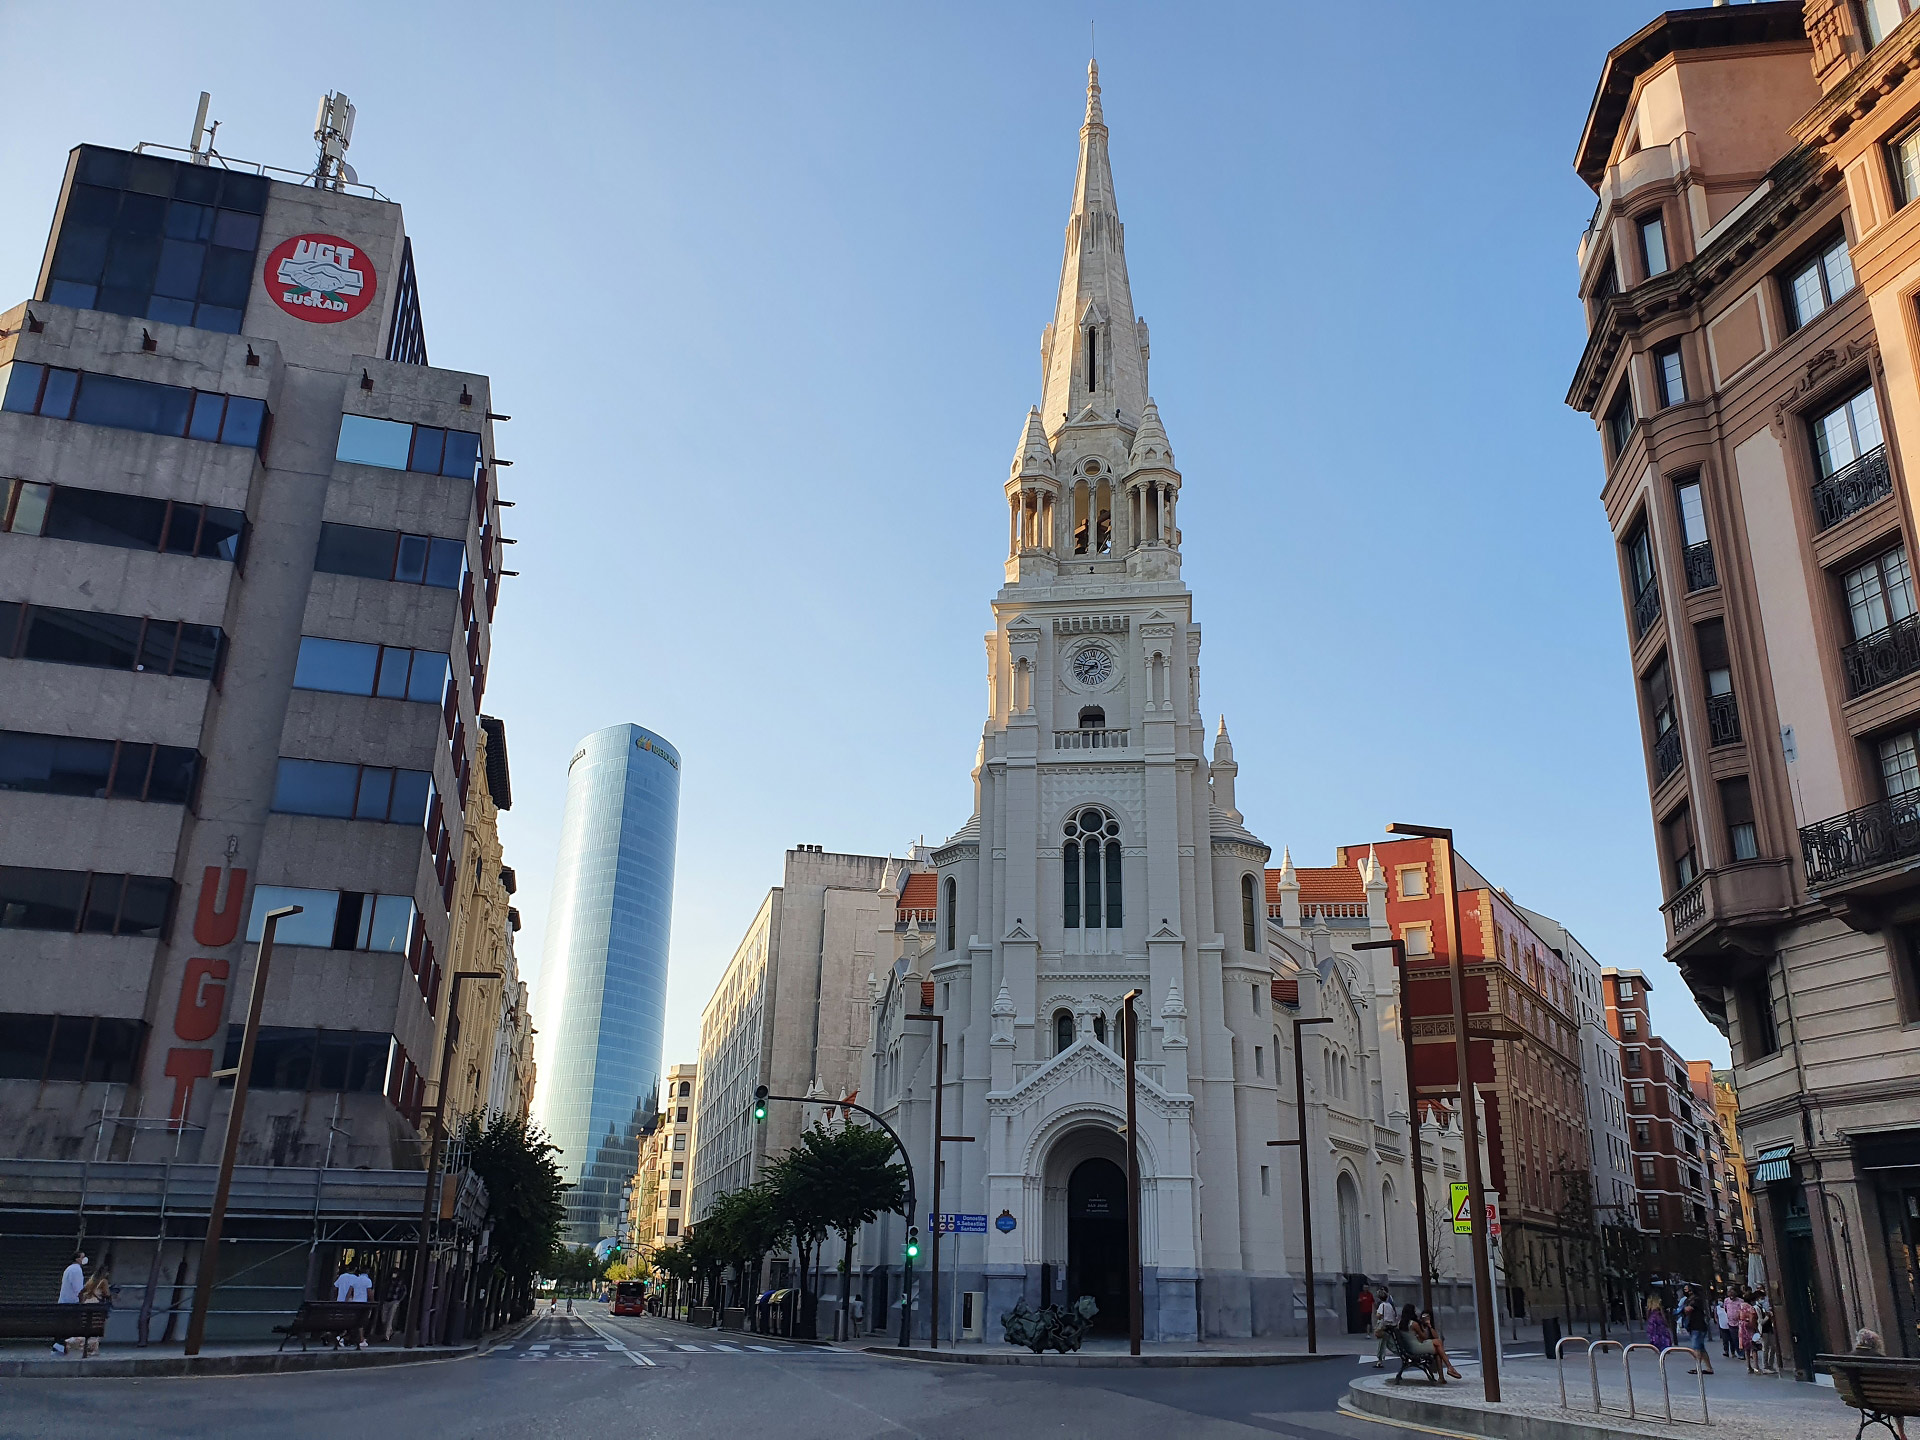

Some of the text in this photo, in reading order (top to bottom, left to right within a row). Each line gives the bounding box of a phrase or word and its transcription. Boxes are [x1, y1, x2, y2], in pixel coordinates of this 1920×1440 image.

[293, 239, 355, 271] UGT
[283, 291, 349, 313] EUSKADI
[164, 865, 248, 1135] UGT
